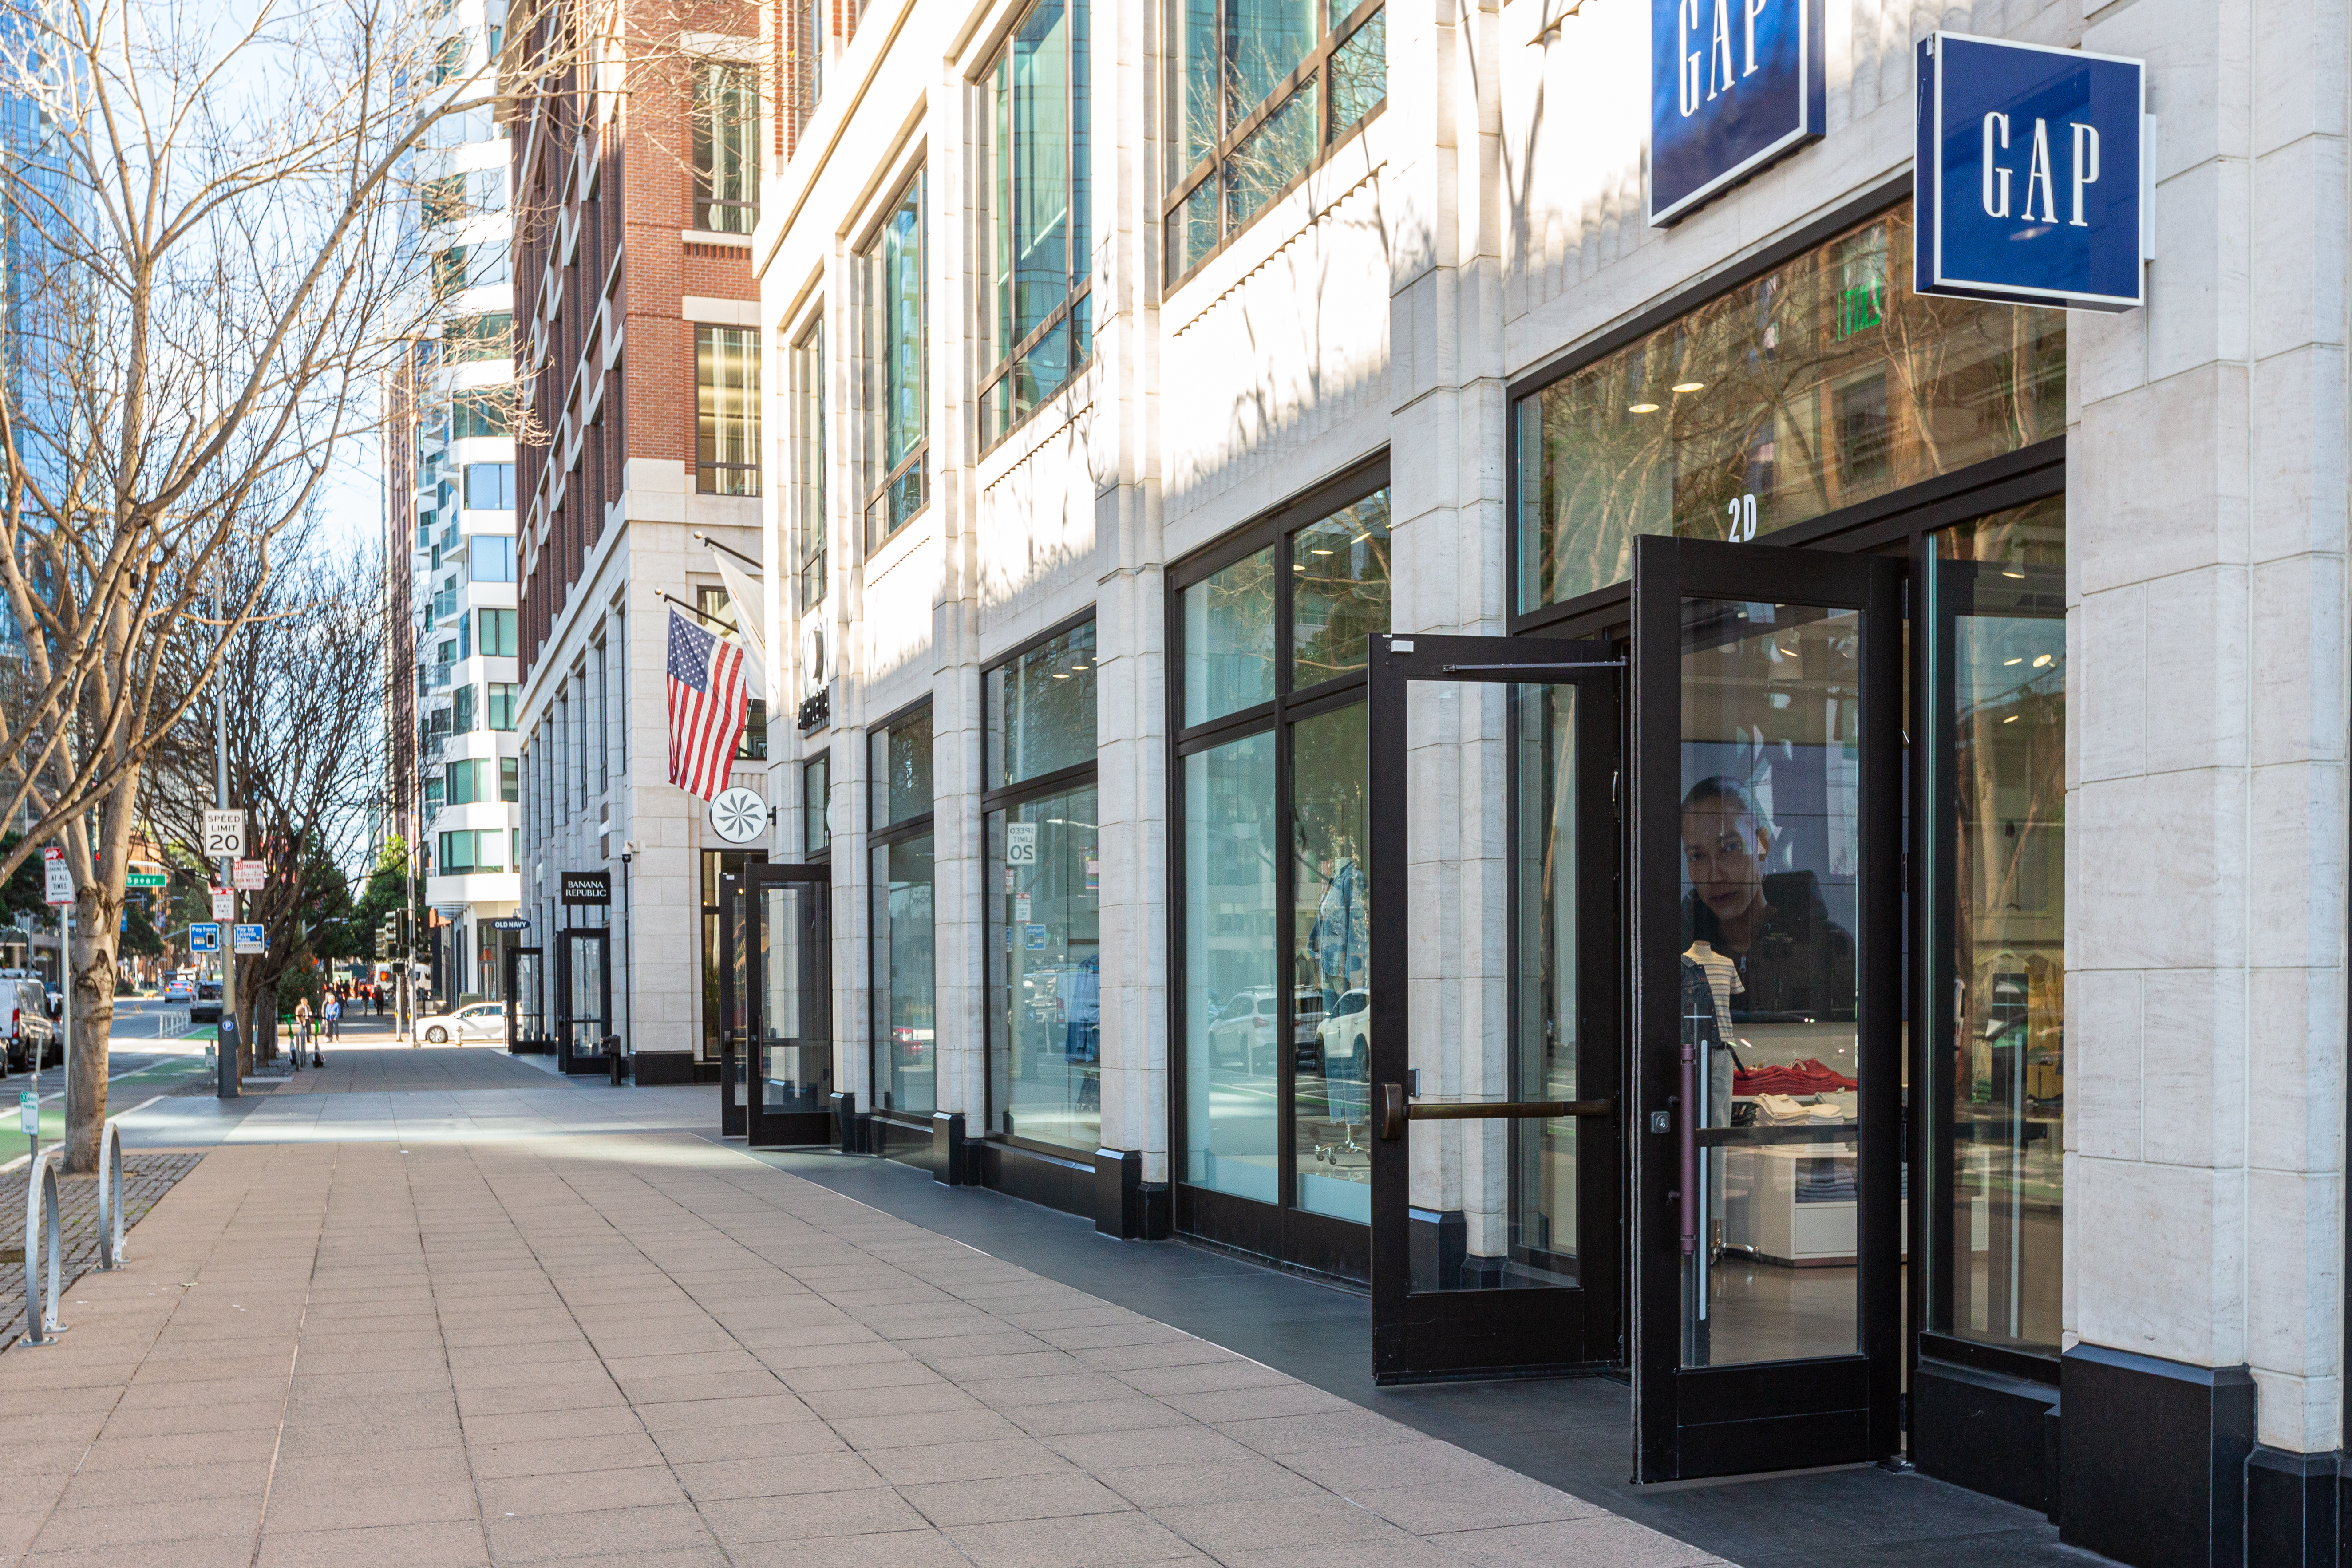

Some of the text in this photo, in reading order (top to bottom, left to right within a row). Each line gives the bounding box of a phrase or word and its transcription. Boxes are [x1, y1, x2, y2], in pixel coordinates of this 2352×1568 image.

[1983, 111, 2099, 226] GAP
[1728, 494, 1756, 543] 2D
[210, 835, 239, 850] 20
[127, 877, 156, 885] Spear
